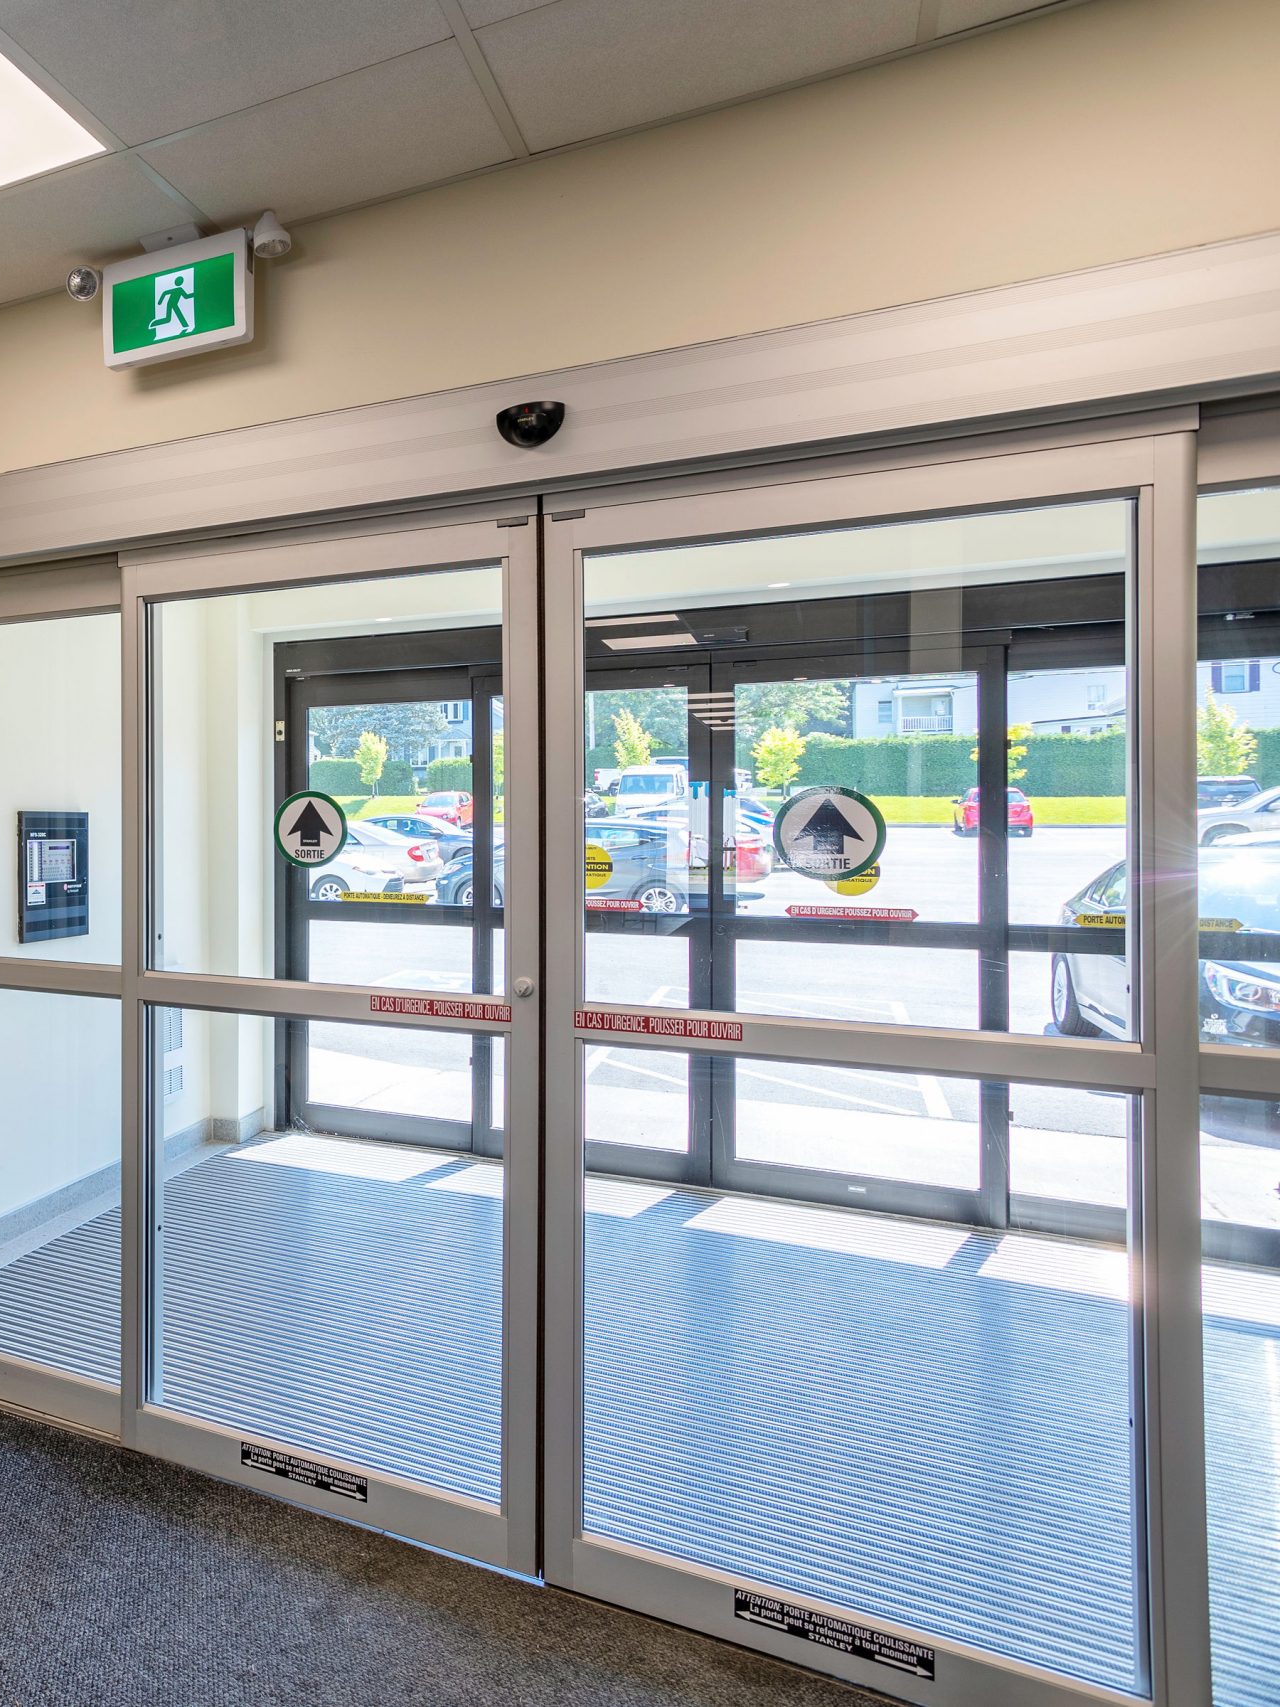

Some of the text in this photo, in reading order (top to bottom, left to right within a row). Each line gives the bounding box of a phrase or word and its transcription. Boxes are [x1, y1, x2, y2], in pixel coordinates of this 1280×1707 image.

[294, 849, 325, 859] SORTIE
[791, 906, 799, 914] EN
[800, 906, 811, 914] CAS
[845, 908, 871, 917] POUSSEZ
[872, 909, 889, 917] POUR
[889, 910, 913, 918] OUVRIR
[1083, 915, 1104, 924] PORTE
[371, 996, 511, 1020] EN CAS D'URGENCE, POUSSER POUR OUVRIR
[575, 1012, 742, 1040] EN CAS D'URGENCE, POUSSER POUR OUVRIR
[272, 1452, 290, 1463] PORTE
[290, 1457, 329, 1476] AUTOMATIQUE
[329, 1469, 367, 1487] COULISSANTE
[288, 1472, 317, 1486] STANLEY
[735, 1590, 934, 1661] ATTENTION: PORTE AUTOMATIQUE COULISSANTE
[750, 1603, 918, 1664] La porte peut se refermer à tout moment
[808, 1632, 853, 1652] STANLEY
